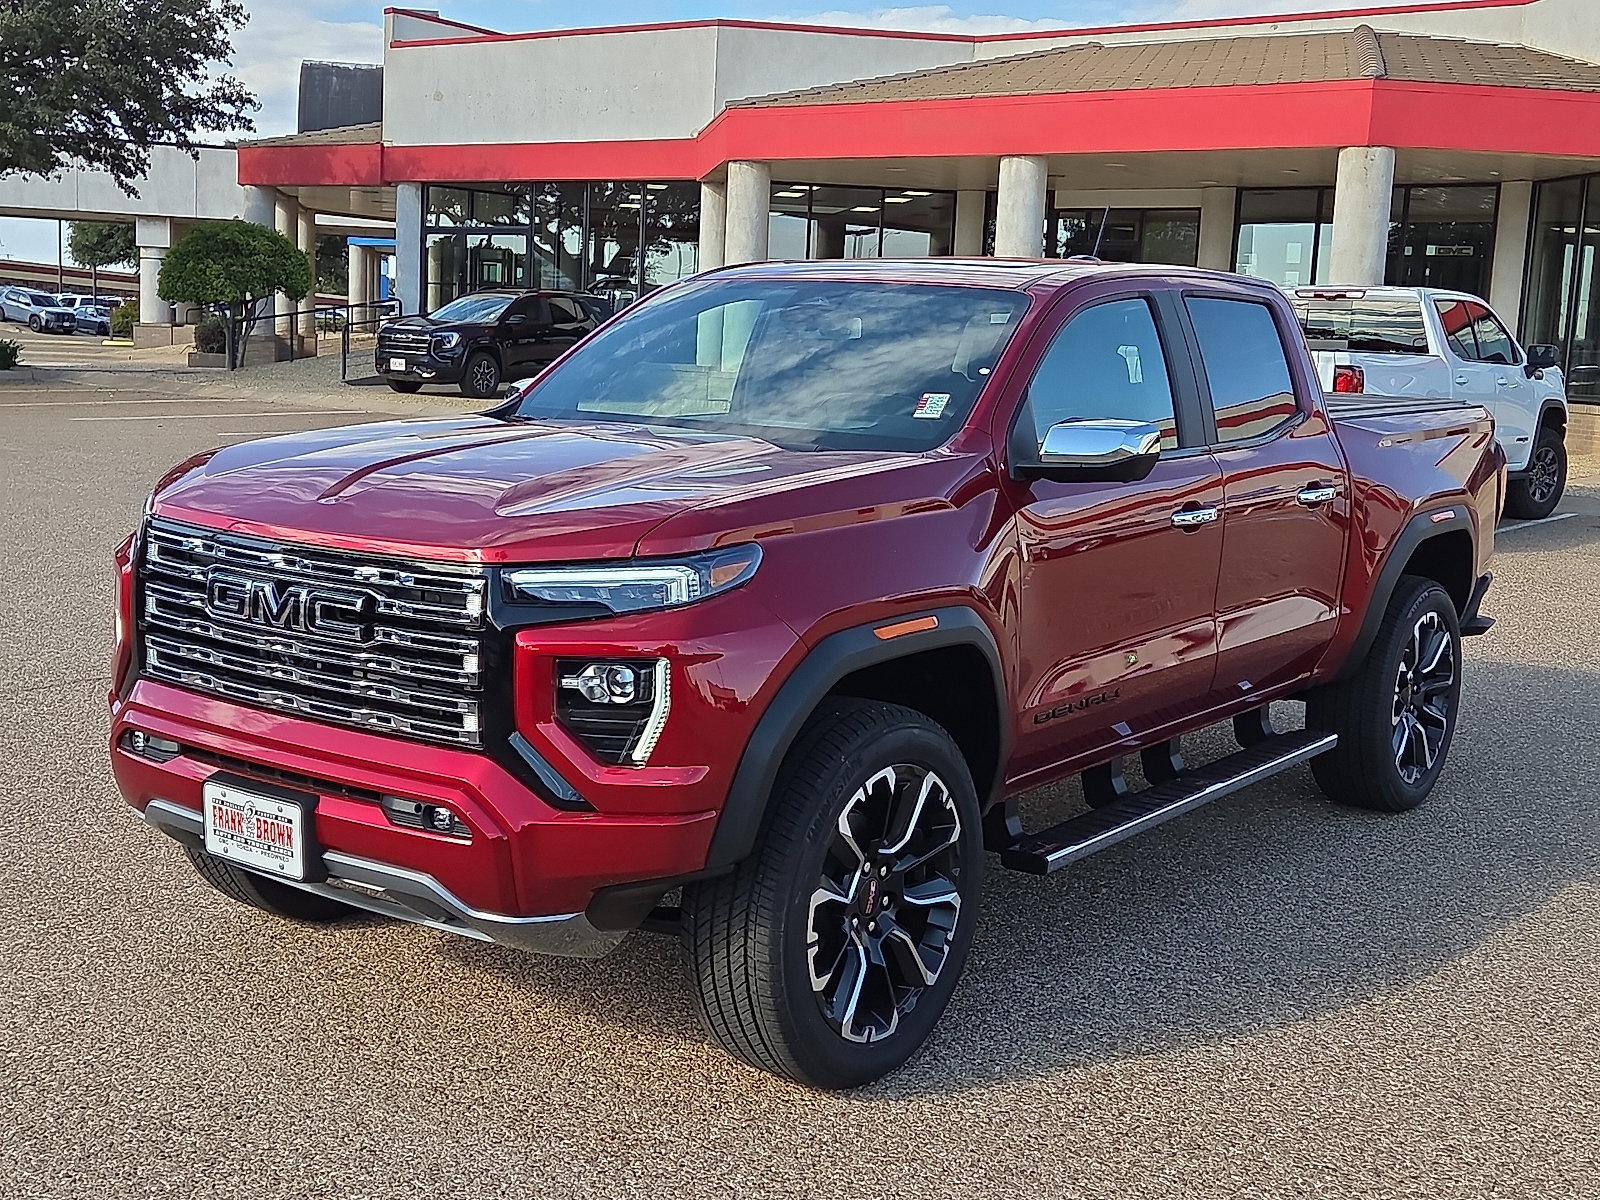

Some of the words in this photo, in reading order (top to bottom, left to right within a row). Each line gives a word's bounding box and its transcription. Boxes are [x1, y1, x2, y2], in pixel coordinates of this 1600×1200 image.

[206, 572, 367, 641] GMC
[1033, 687, 1121, 725] DENALI
[212, 805, 245, 834] FRANK
[256, 817, 293, 848] BROWN
[215, 830, 232, 839] AUTO
[233, 834, 246, 844] AND
[247, 838, 269, 850] TRUCK
[865, 881, 876, 914] GMC
